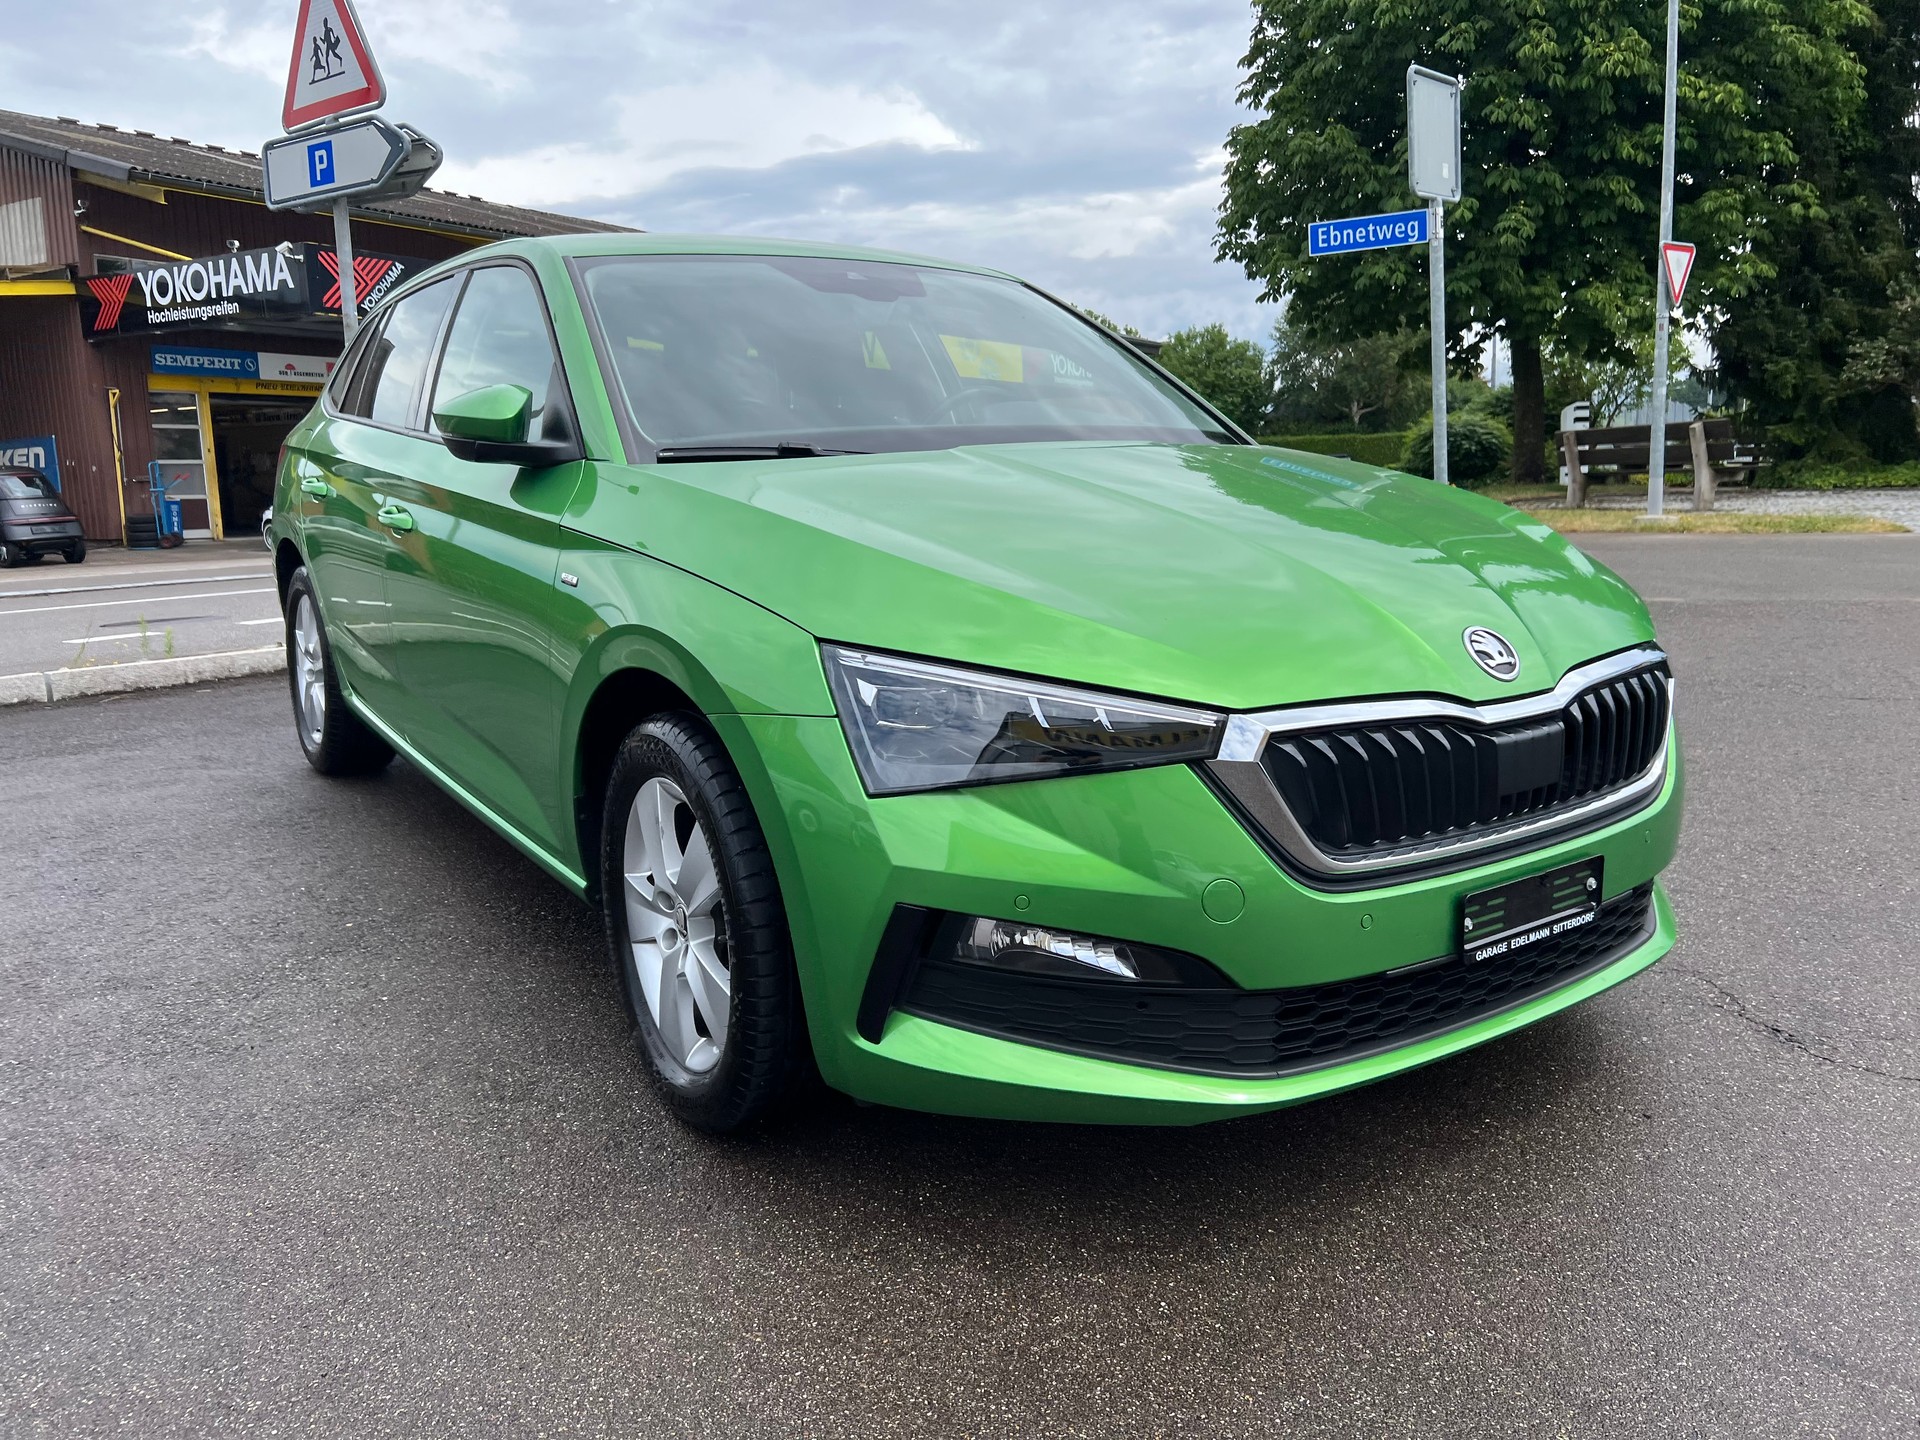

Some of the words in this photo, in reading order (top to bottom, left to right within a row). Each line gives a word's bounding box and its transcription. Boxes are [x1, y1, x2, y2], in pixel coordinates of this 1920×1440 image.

[315, 149, 328, 181] P
[1318, 220, 1419, 248] Ebnetweg
[137, 251, 295, 307] YOKOHAMA
[360, 261, 405, 312] YOKOHAMA
[147, 300, 240, 324] Hochleistungsreifen
[154, 353, 241, 370] SEMPERIT
[1475, 941, 1508, 961] GARAGE
[1510, 927, 1550, 949] EDELMANN
[1552, 911, 1595, 935] SITTERDORF
